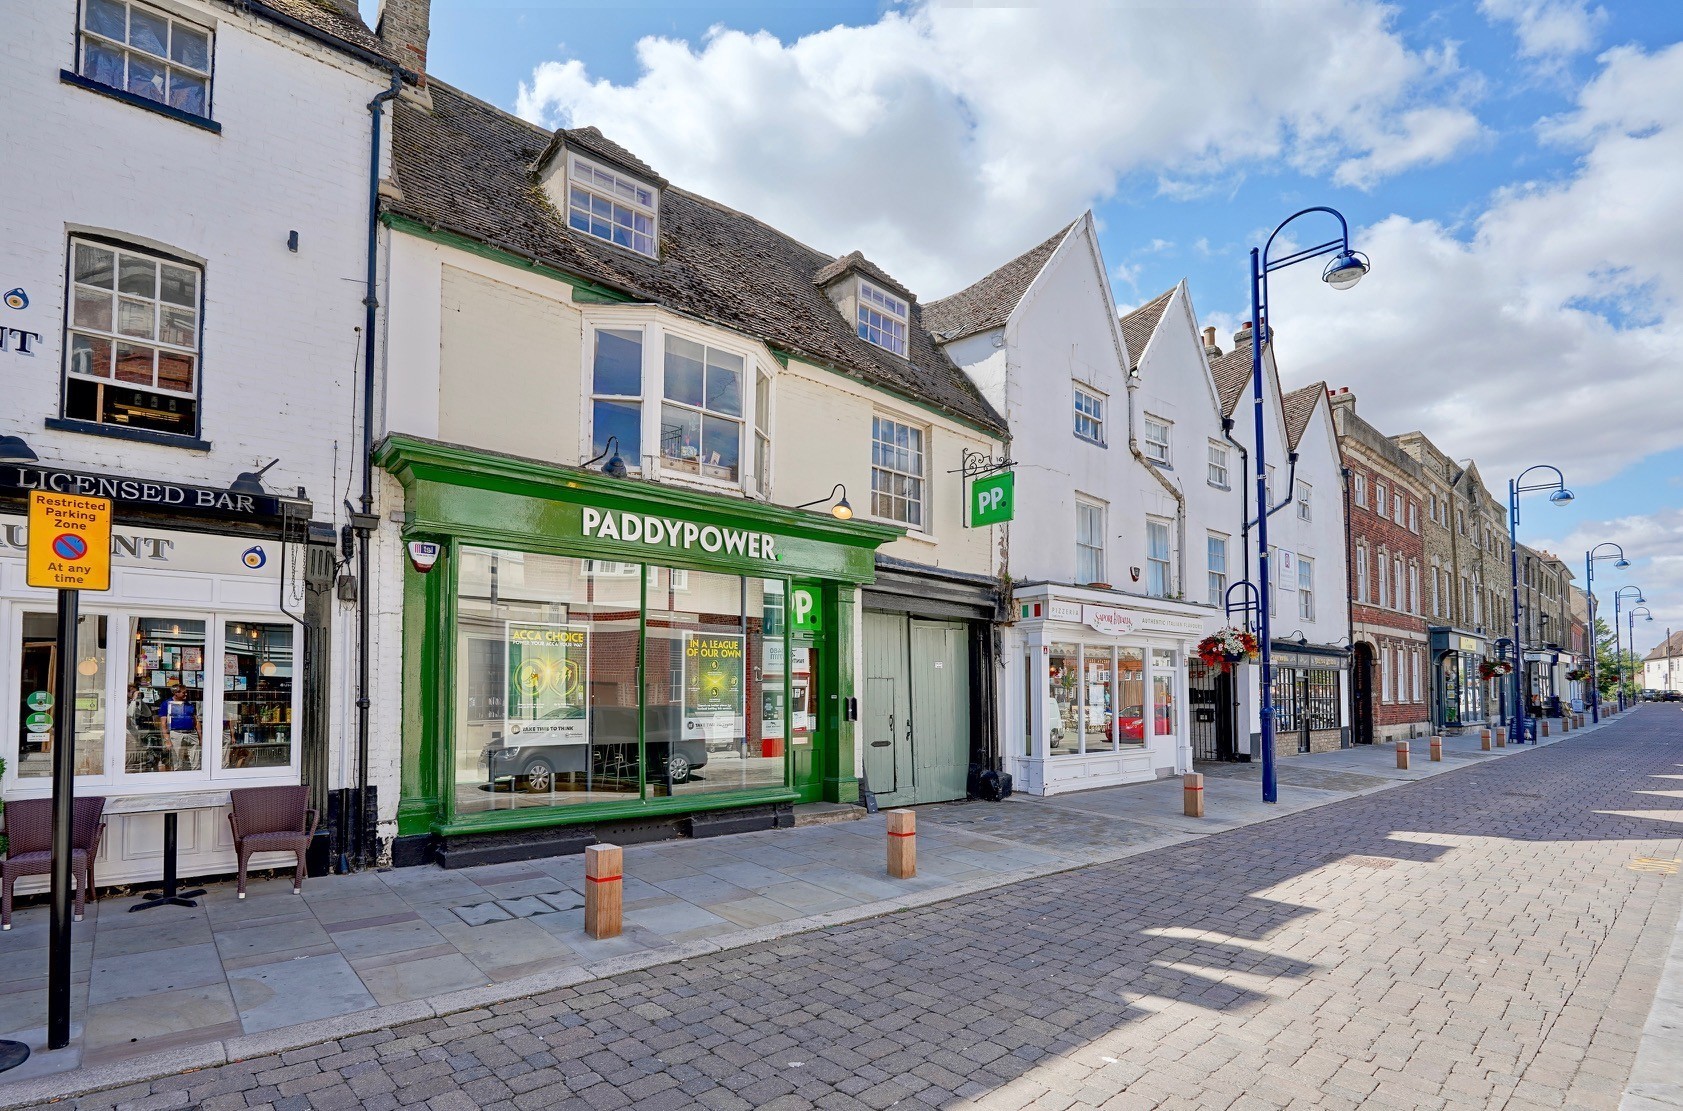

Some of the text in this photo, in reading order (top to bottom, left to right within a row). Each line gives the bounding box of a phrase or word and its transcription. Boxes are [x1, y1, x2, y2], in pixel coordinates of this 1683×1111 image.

[17, 468, 256, 513] LICENSED BAR
[36, 495, 106, 511] Restricted
[46, 507, 96, 522] Parking
[54, 519, 87, 530] Zone
[47, 562, 91, 575] At any
[54, 574, 84, 583] time
[1051, 607, 1079, 616] PIZZERIA
[512, 630, 584, 643] ACCA CHOICE
[689, 639, 739, 650] IN A LEAGUE
[686, 648, 742, 658] OF OUR OWN
